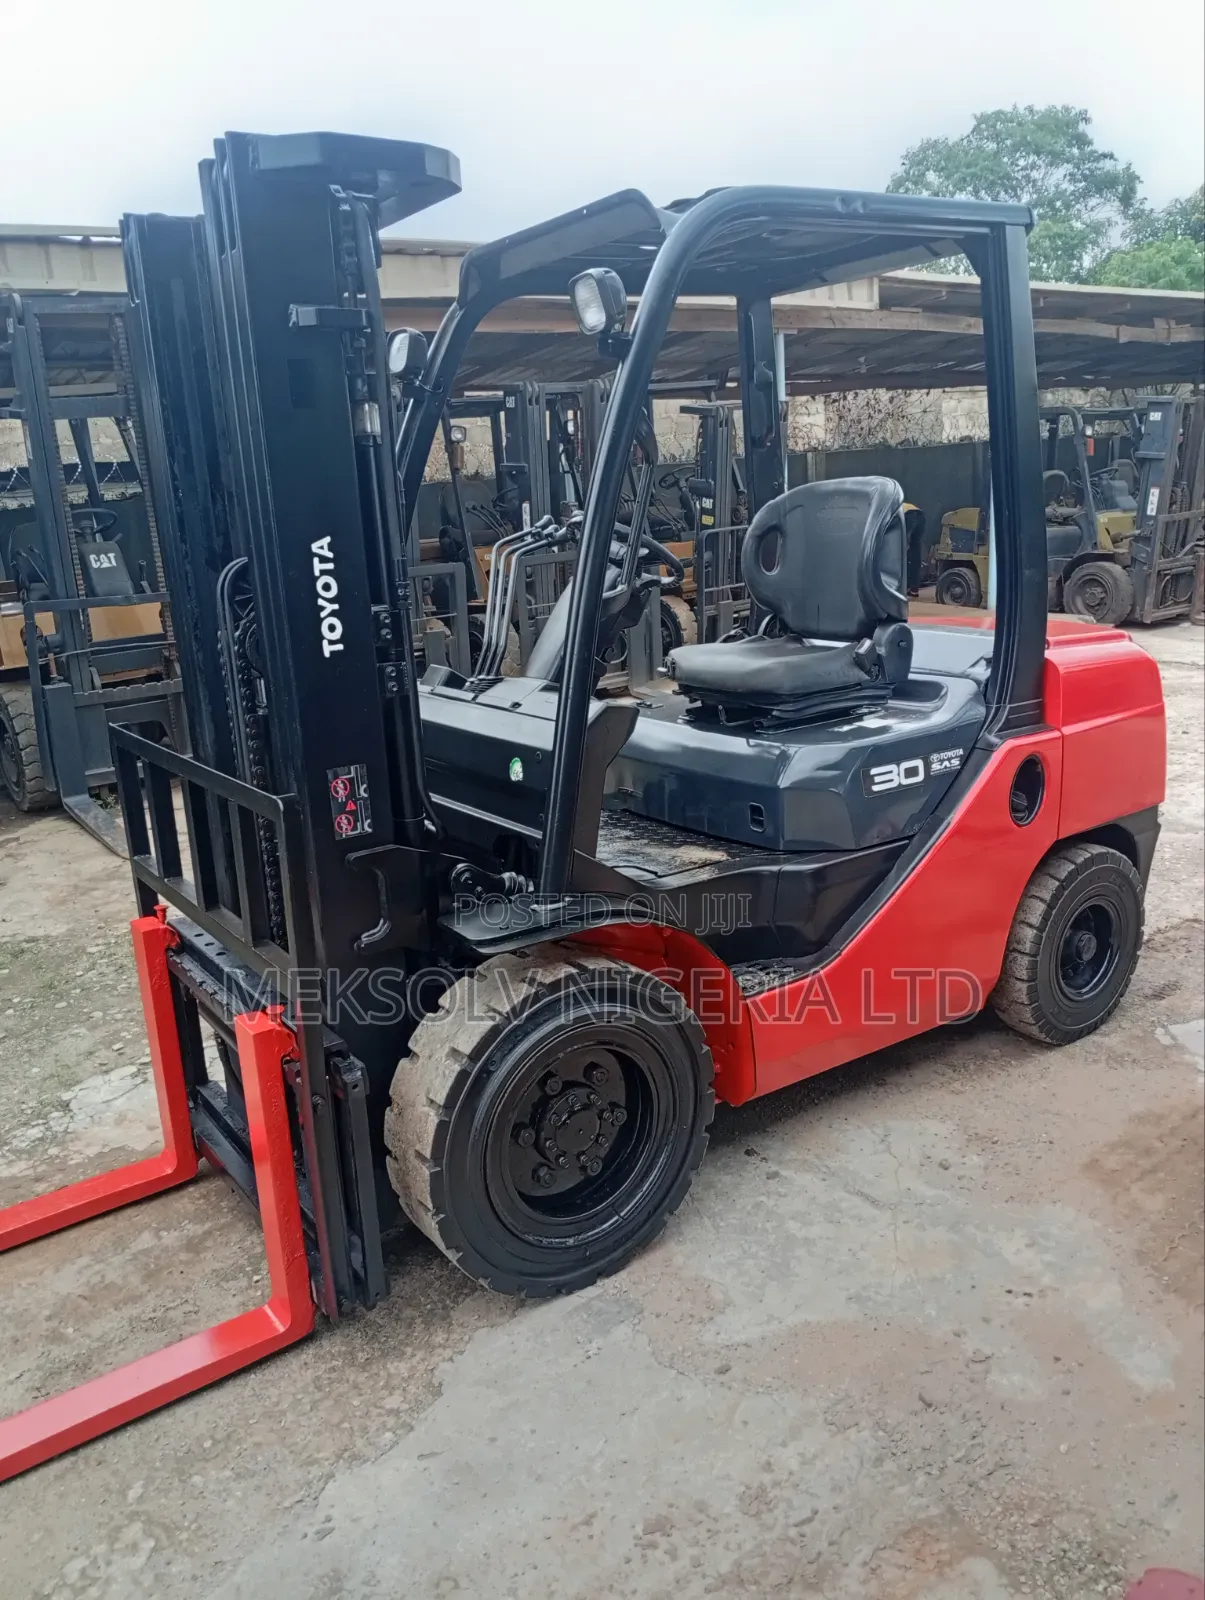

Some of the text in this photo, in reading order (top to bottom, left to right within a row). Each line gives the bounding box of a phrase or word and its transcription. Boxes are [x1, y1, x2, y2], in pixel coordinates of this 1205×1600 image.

[702, 497, 713, 509] CAT
[89, 552, 117, 568] CAT
[311, 535, 344, 658] TOYOTA
[940, 748, 963, 760] TOYOTA
[931, 758, 960, 771] SAS
[870, 759, 924, 791] 30
